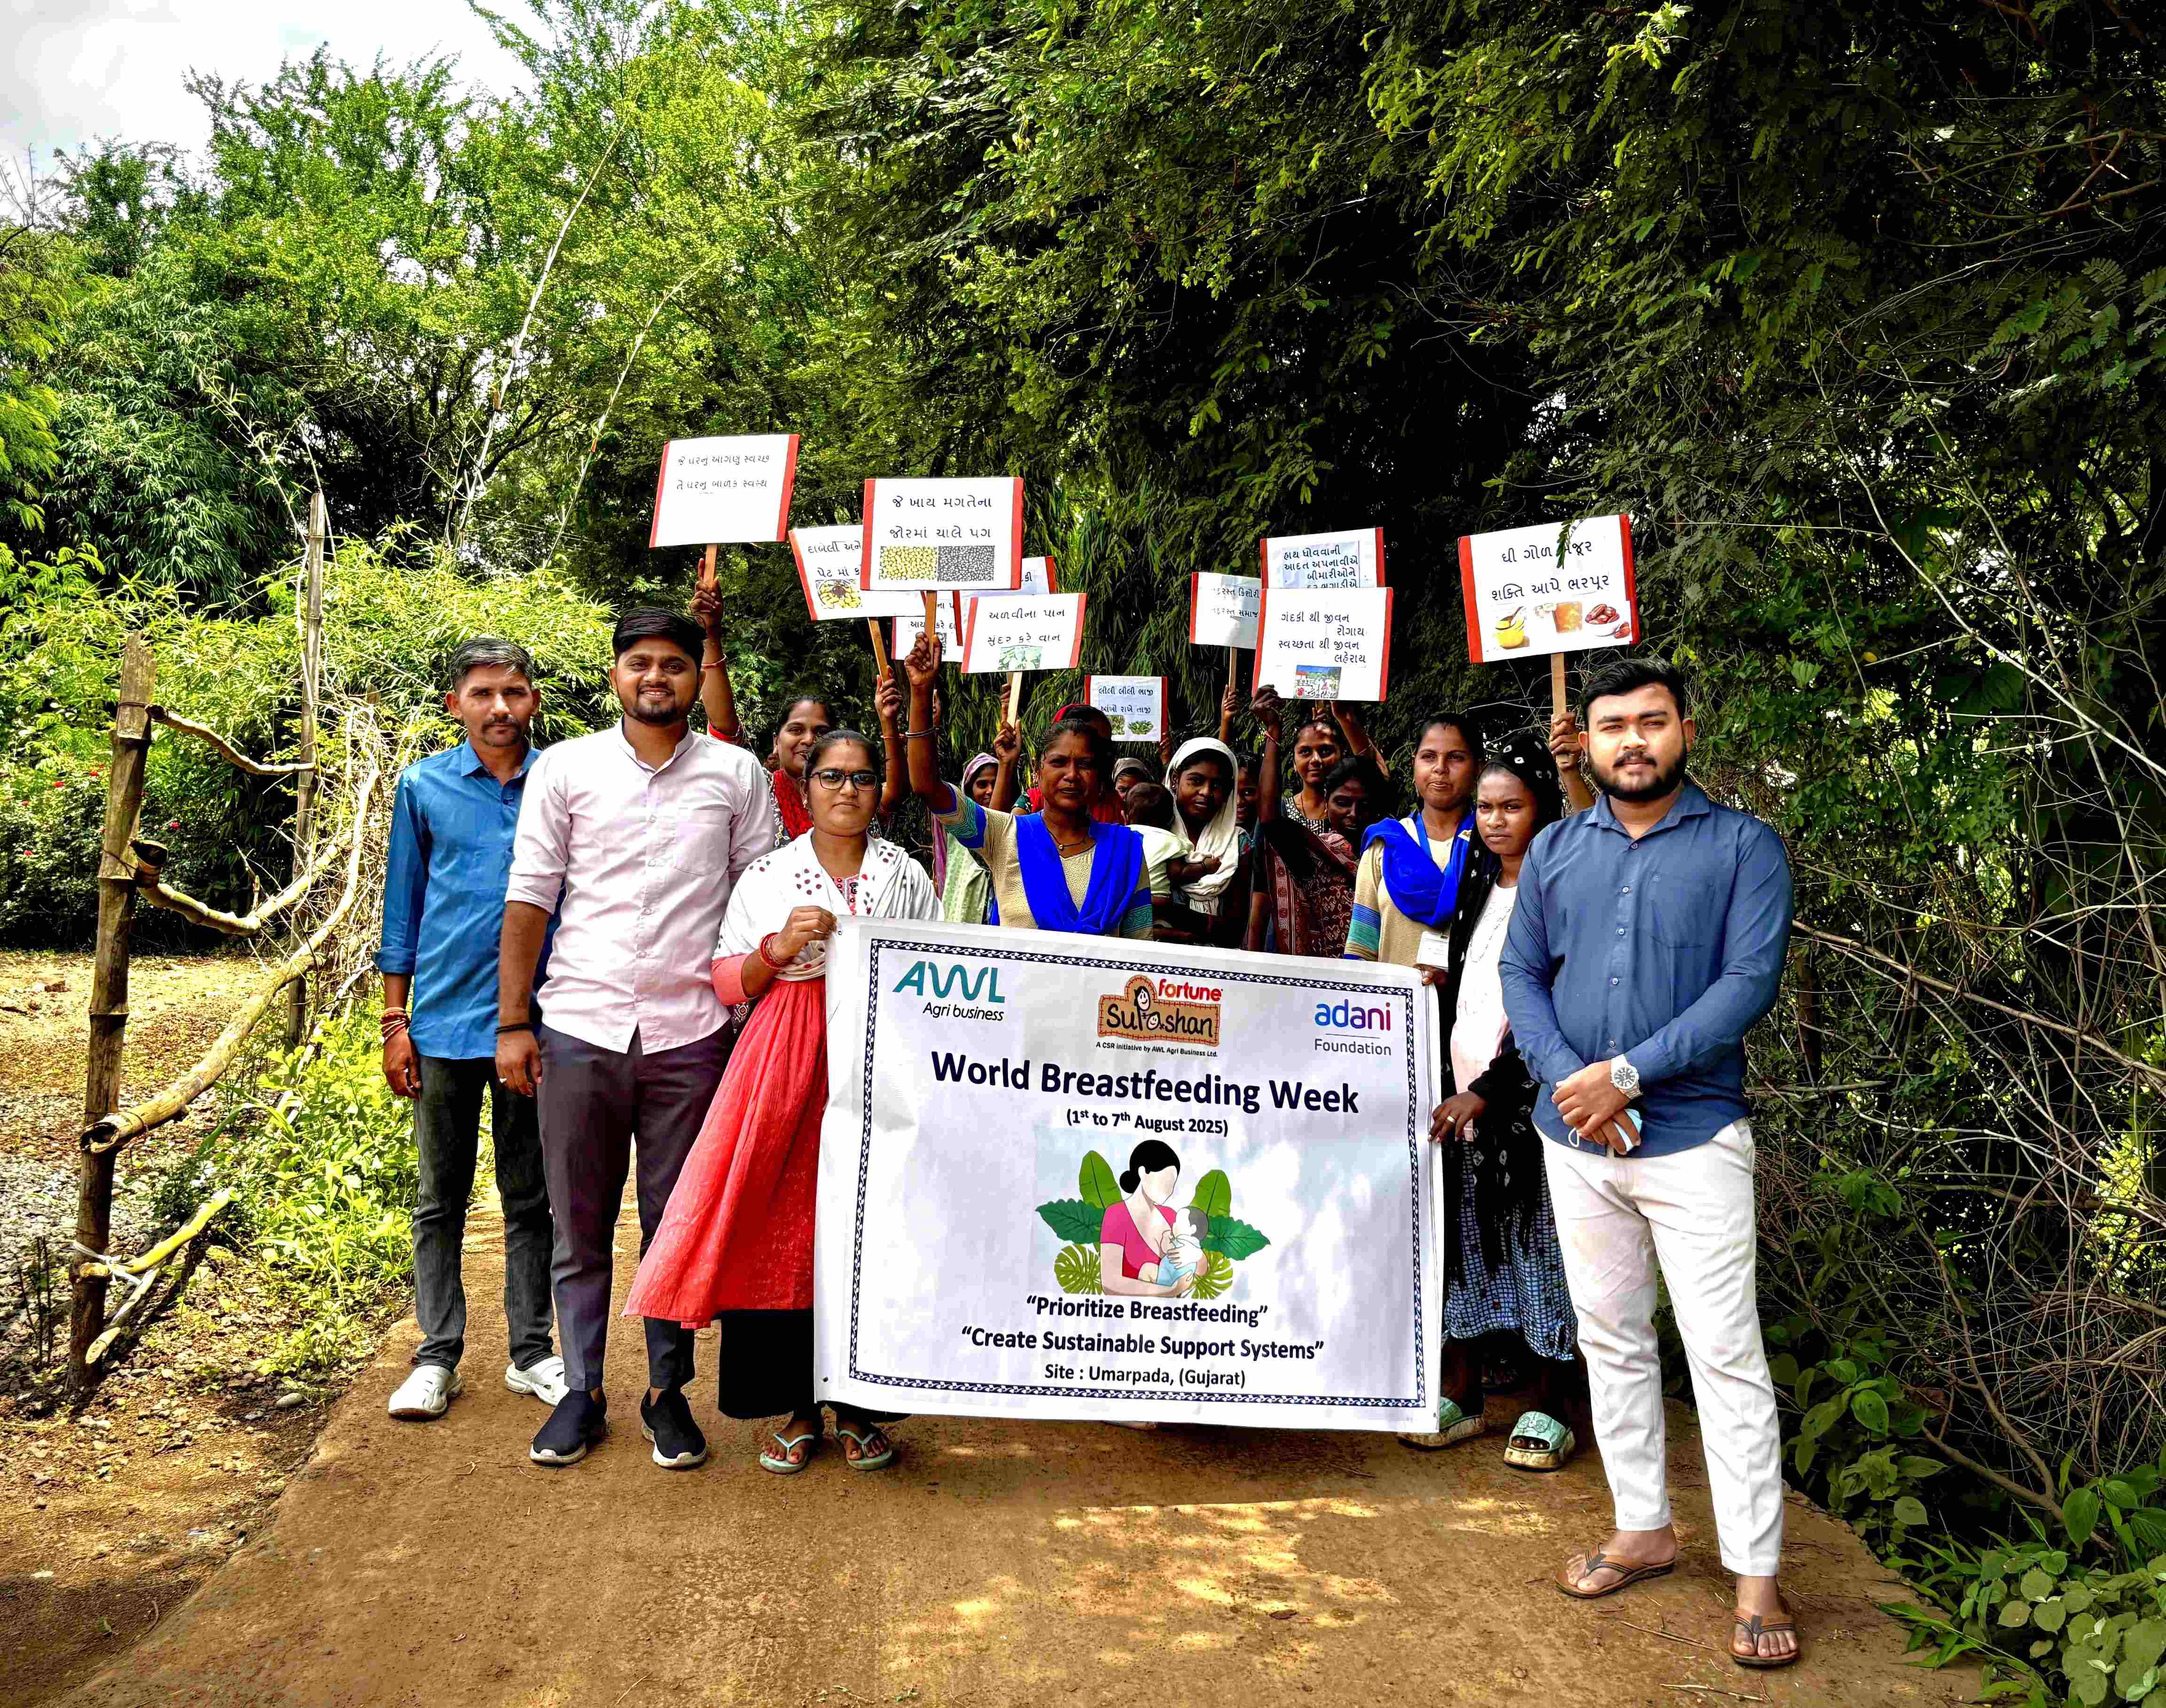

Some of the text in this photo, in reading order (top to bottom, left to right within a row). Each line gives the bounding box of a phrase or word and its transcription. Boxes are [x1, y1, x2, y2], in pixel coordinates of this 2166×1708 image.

[892, 495, 903, 507] જે
[910, 498, 935, 507] ખાય
[890, 525, 991, 538] જોરમાં ચાલે પગ
[1284, 551, 1299, 560] હાથ
[1501, 547, 1517, 562] ઘી
[1524, 545, 1553, 559] ગોળ
[1284, 555, 1358, 571] આદત અપનાવીએ
[1307, 567, 1356, 580] બીમારીઓને
[1492, 575, 1609, 601] શક્તિ આપે ભરપૂર
[989, 608, 1036, 619] અળવીના
[1309, 611, 1320, 622] થી
[1324, 614, 1349, 624] જીવન
[1019, 632, 1031, 643] કરે
[1319, 638, 1329, 649] થી
[1334, 641, 1360, 650] જીવન
[1335, 651, 1366, 663] લહેરાય
[1099, 686, 1115, 694] લીલી
[1118, 686, 1135, 695] લીલી
[892, 960, 1005, 1003] AWL
[1158, 978, 1222, 1001] fortune
[923, 1002, 1004, 1021] Agri business
[1315, 999, 1391, 1031] adani
[1315, 1038, 1391, 1056] Foundation
[931, 1051, 1358, 1114] World Breastfeeding Week
[1092, 1113, 1108, 1126] to
[1112, 1112, 1130, 1127] 7th
[1134, 1115, 1185, 1133] August
[1189, 1119, 1228, 1138] 2025)
[1026, 1295, 1267, 1327] “Prioritize Breastfeeding”
[962, 1326, 1324, 1362] “Create Sustainable Support Systems”
[1044, 1364, 1074, 1380] Site
[1089, 1366, 1174, 1387] Umarpada,
[1180, 1369, 1246, 1389] (Gujarat)
